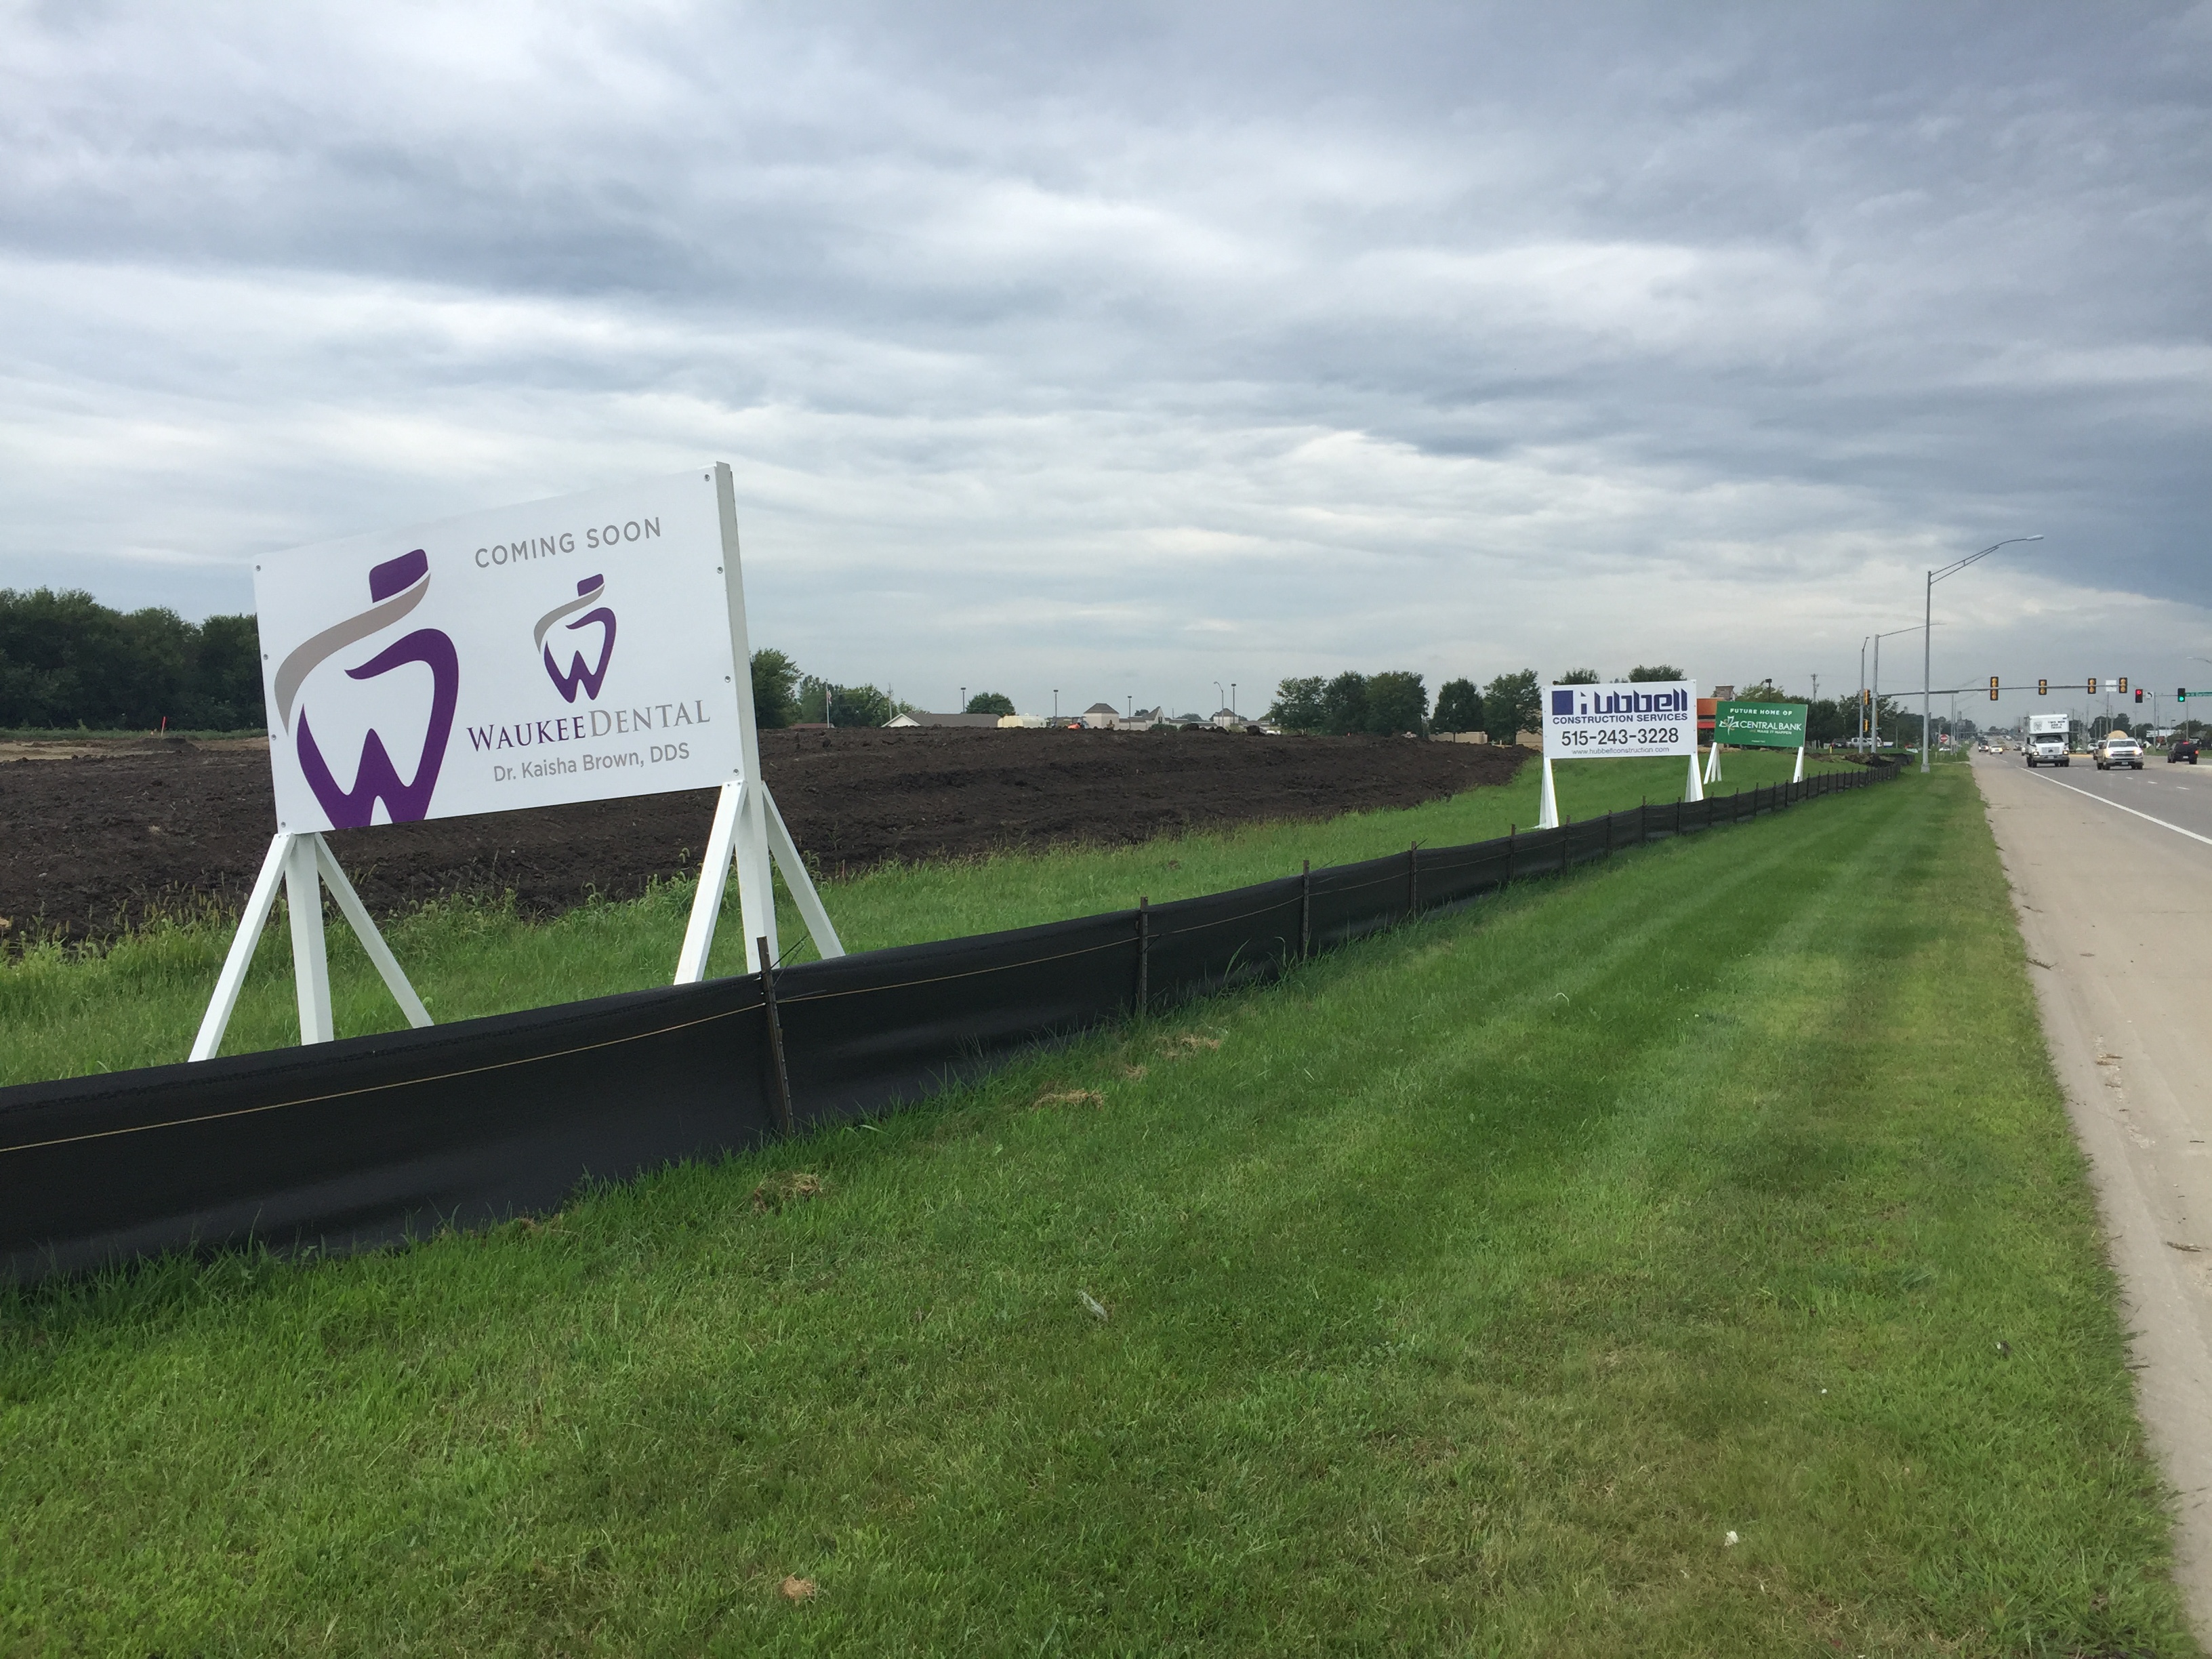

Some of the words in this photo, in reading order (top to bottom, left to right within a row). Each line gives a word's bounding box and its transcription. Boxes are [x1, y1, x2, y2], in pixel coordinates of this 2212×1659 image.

[475, 533, 575, 568] COMING
[587, 517, 661, 549] SOON
[1553, 714, 1633, 724] CONSTRUCTION
[1637, 713, 1687, 722] SERVICES
[1740, 720, 1778, 730] CENTRAL
[1779, 722, 1802, 731] BANK
[1561, 727, 1679, 746] 515-243-3228
[493, 765, 516, 781] Dr.
[522, 757, 577, 778] Kaisha
[583, 751, 644, 771] Brown,
[650, 742, 690, 763] DDS
